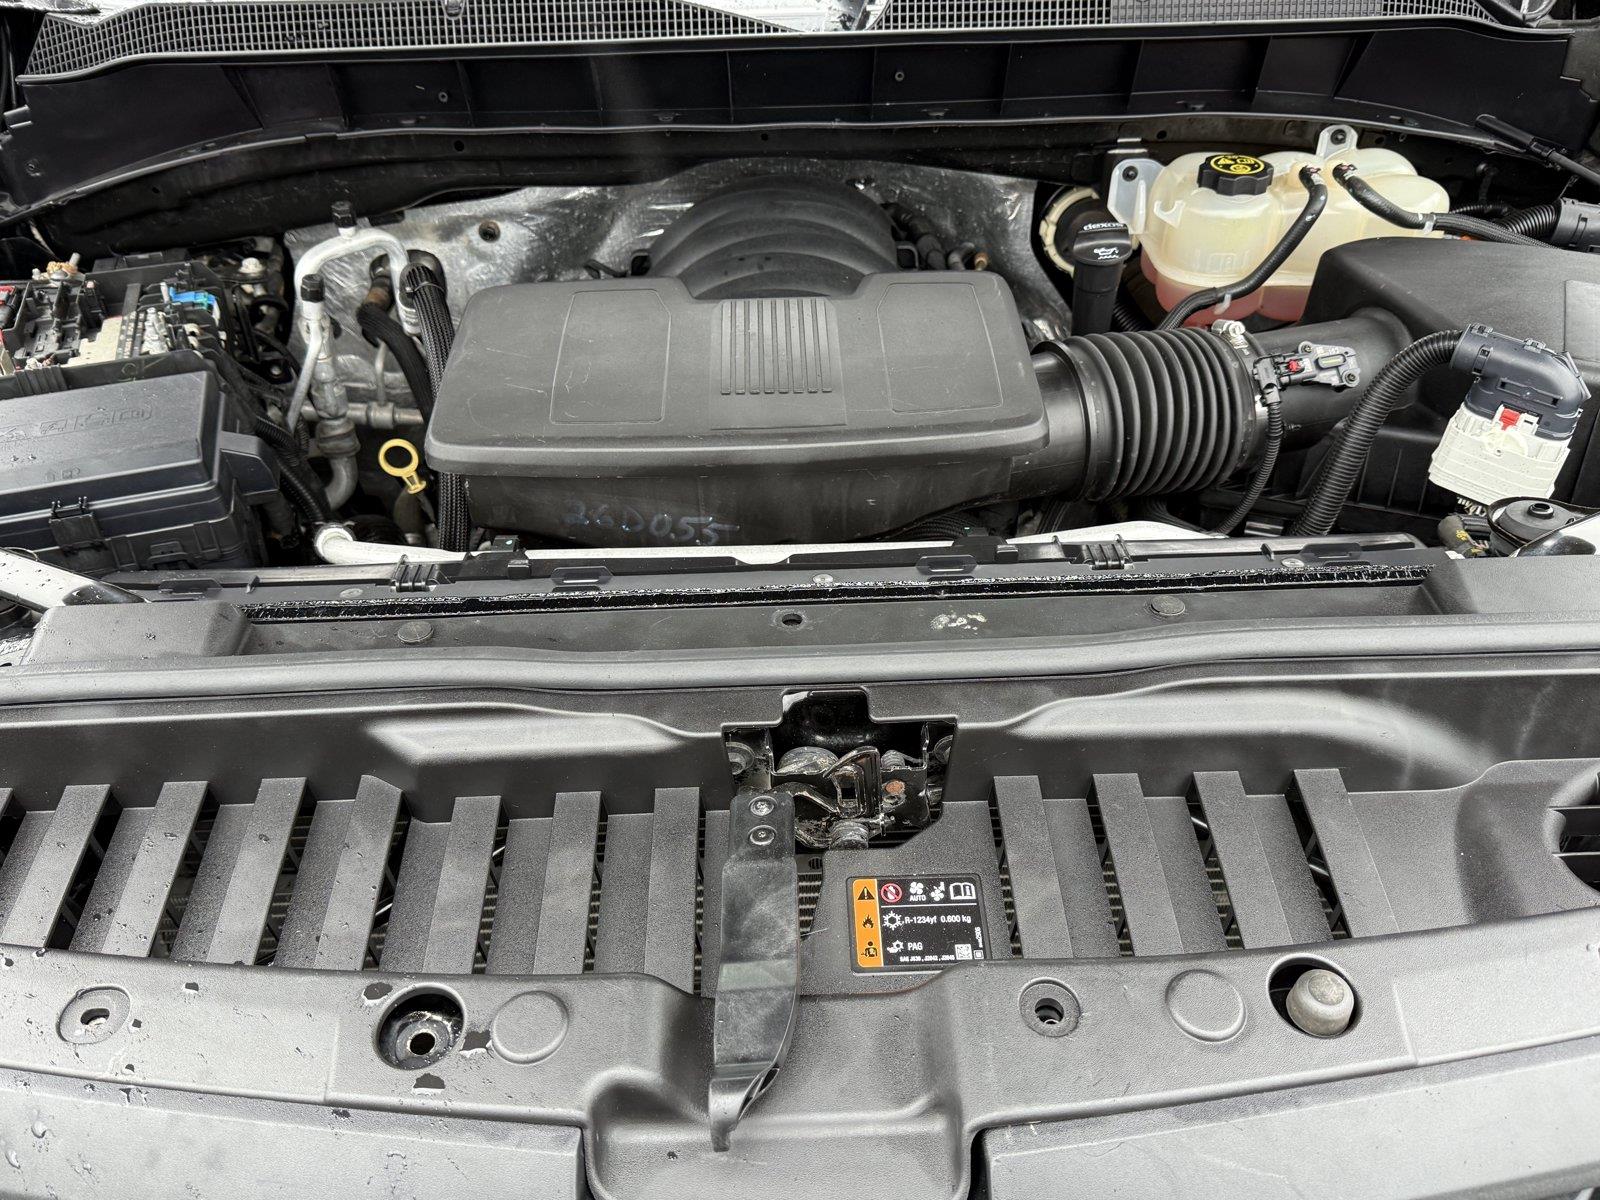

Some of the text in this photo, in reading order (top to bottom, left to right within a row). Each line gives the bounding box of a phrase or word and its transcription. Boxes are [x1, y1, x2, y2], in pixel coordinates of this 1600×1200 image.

[909, 894, 926, 902] AUTO
[904, 914, 972, 924] R-1234yf 0.600 kg
[907, 942, 923, 951] PAG
